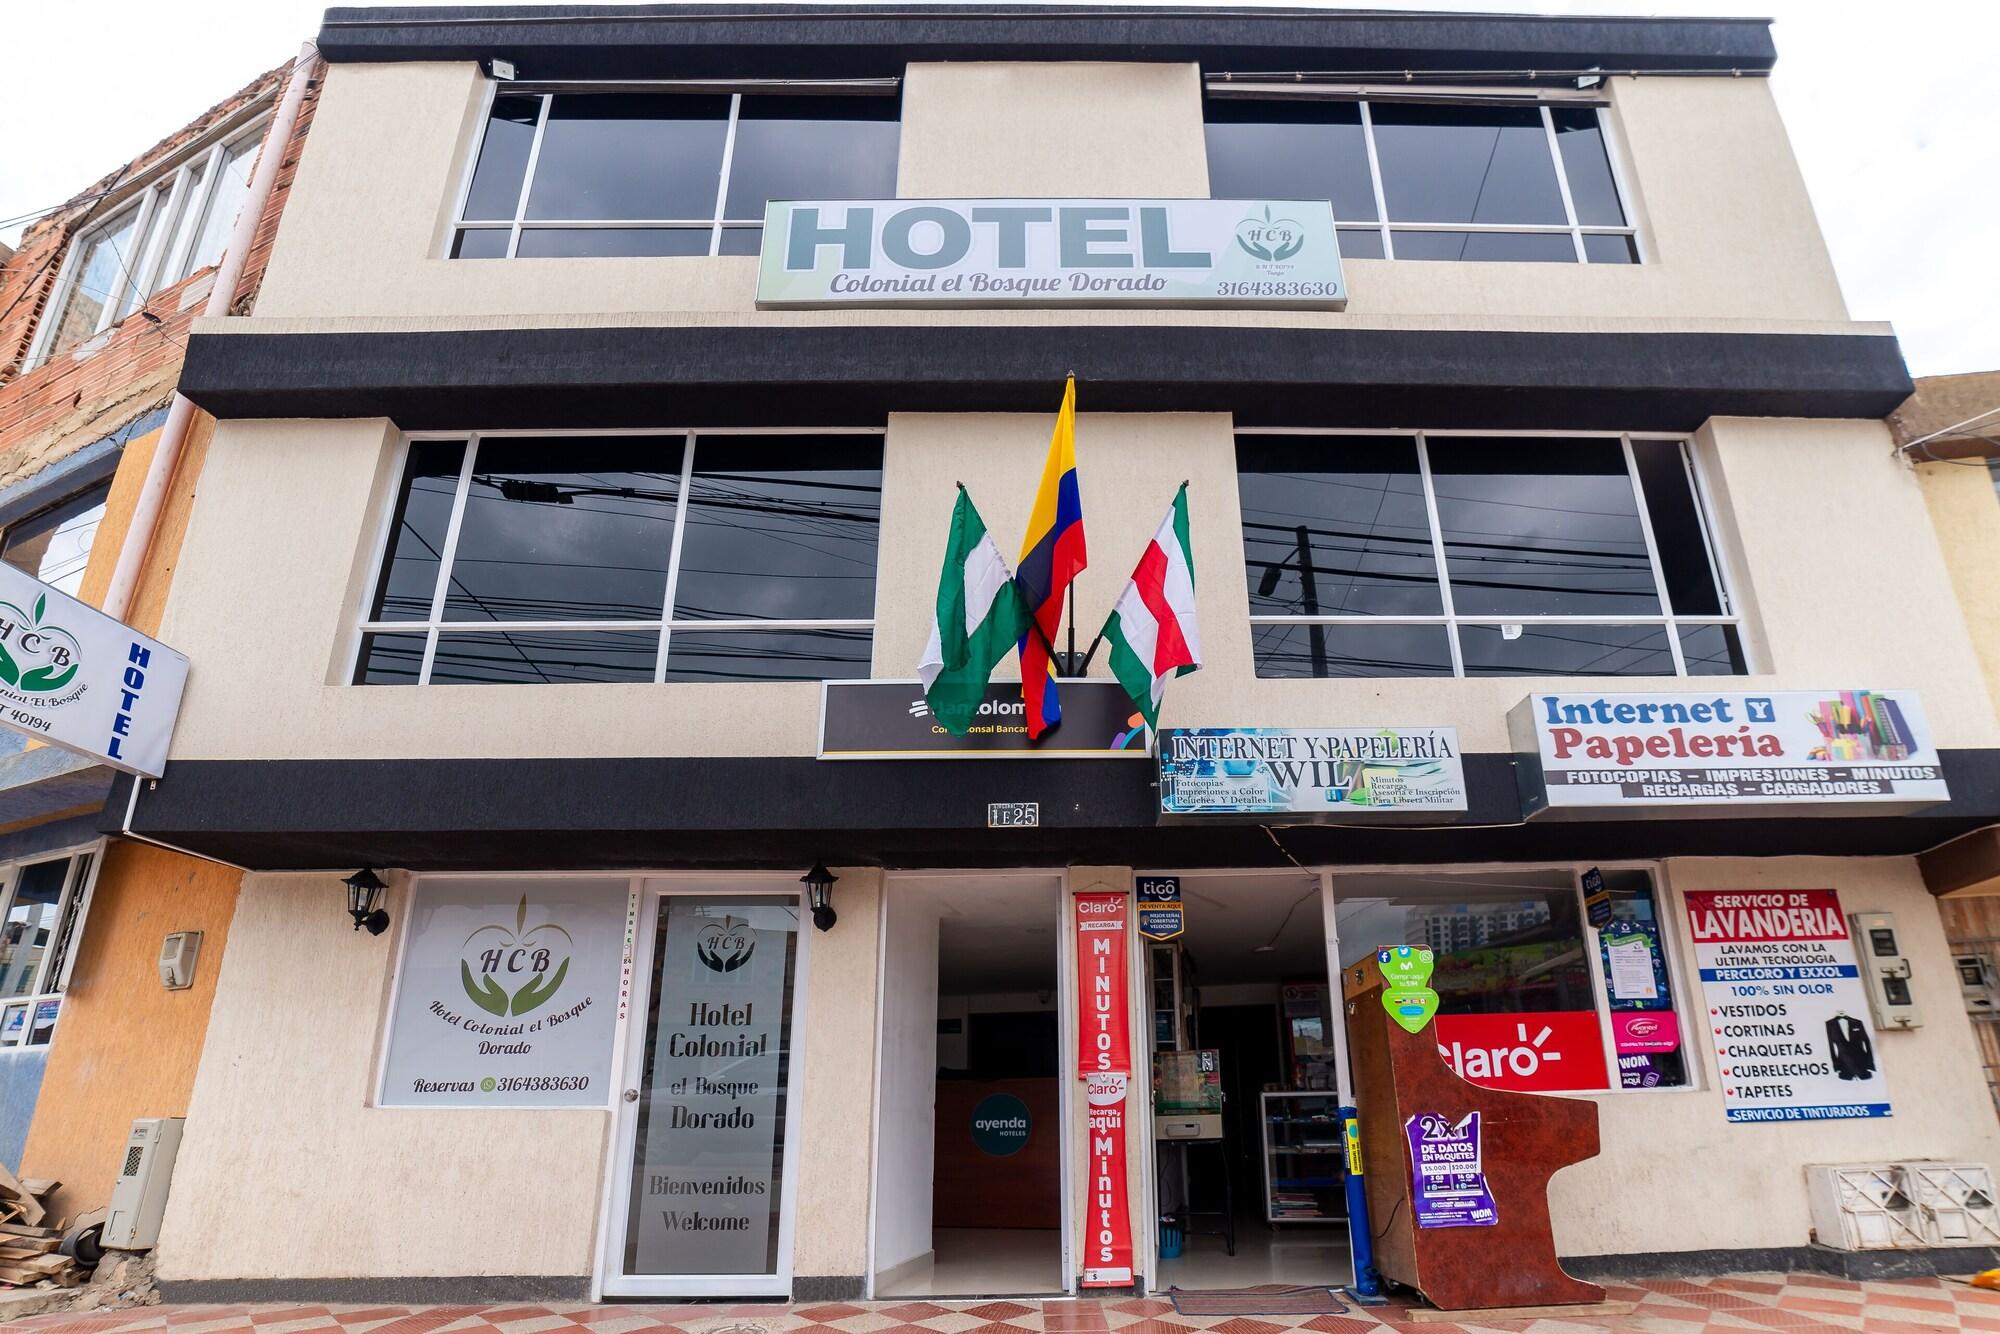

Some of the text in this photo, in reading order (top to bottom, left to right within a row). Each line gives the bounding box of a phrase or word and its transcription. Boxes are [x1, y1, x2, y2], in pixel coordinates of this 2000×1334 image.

[786, 206, 1212, 271] HOTEL
[830, 271, 1168, 297] Colonial el Bosque Dorado
[1217, 281, 1337, 296] 3164383630
[49, 683, 89, 707] Bosque
[107, 642, 151, 760] HOTEL
[1543, 696, 1734, 725] Internet
[10, 709, 52, 732] 40194
[996, 725, 1029, 734] Bancar
[1172, 731, 1454, 760] INTERNET Y PAPELERÍA
[1549, 726, 1785, 765] Papelería
[1267, 760, 1352, 789] WIL
[1567, 769, 1682, 785] FOTOCOPIAS
[1705, 768, 1829, 783] IMPRESIONES
[1852, 766, 1937, 781] MINUTOS
[1176, 780, 1224, 789] Fotocopias
[1177, 788, 1230, 796] Impresiones
[1371, 783, 1408, 791] Recargas
[1642, 782, 1739, 797] RECARGAS
[1760, 781, 1882, 796] CARGADORES
[1177, 796, 1215, 804] Peluches
[1230, 796, 1267, 804] Detalles
[1393, 796, 1422, 804] Libreta
[1424, 796, 1454, 804] Militar
[1079, 901, 1118, 913] Claro
[1714, 894, 1809, 908] SERVICIO DE
[1690, 908, 1845, 938] LAVANDERIA
[1720, 943, 1826, 955] LAVAMOS CON LA
[1715, 955, 1837, 966] ULTIMA TECNOLOGIA
[1716, 967, 1843, 980] PERCLORO Y EXXOL
[619, 968, 630, 1020] HORAS
[1731, 984, 1834, 996] 100% SIN OLOR
[1093, 938, 1112, 1071] MINUTOS
[1718, 1004, 1787, 1018] VESTIDOS
[429, 996, 593, 1036] Hotel Colonial el Bosque
[688, 1002, 753, 1027] Hotel
[1724, 1024, 1795, 1037] CORTINAS
[478, 1040, 532, 1055] Dorado
[669, 1032, 767, 1058] Colonial
[1728, 1043, 1812, 1058] CHAQUETAS
[1619, 1055, 1650, 1069] WOM
[1732, 1063, 1829, 1078] CUBRELECHOS
[413, 1076, 589, 1093] Reservas 3164383630
[671, 1077, 758, 1100] el Bosque
[1088, 1083, 1118, 1095] Claro
[1736, 1085, 1793, 1098] TAPETES
[670, 1105, 754, 1129] Dorado
[1733, 1106, 1870, 1121] SERVICIO DE TINTURADOS
[975, 1117, 1026, 1131] ayenda
[1421, 1143, 1474, 1154] DE DATOS
[1435, 1152, 1475, 1162] PAQUETES
[650, 1175, 765, 1196] Bienvenidos
[1095, 1137, 1113, 1262] Minutos
[1471, 1208, 1493, 1219] WOM
[662, 1211, 750, 1232] Welcome
